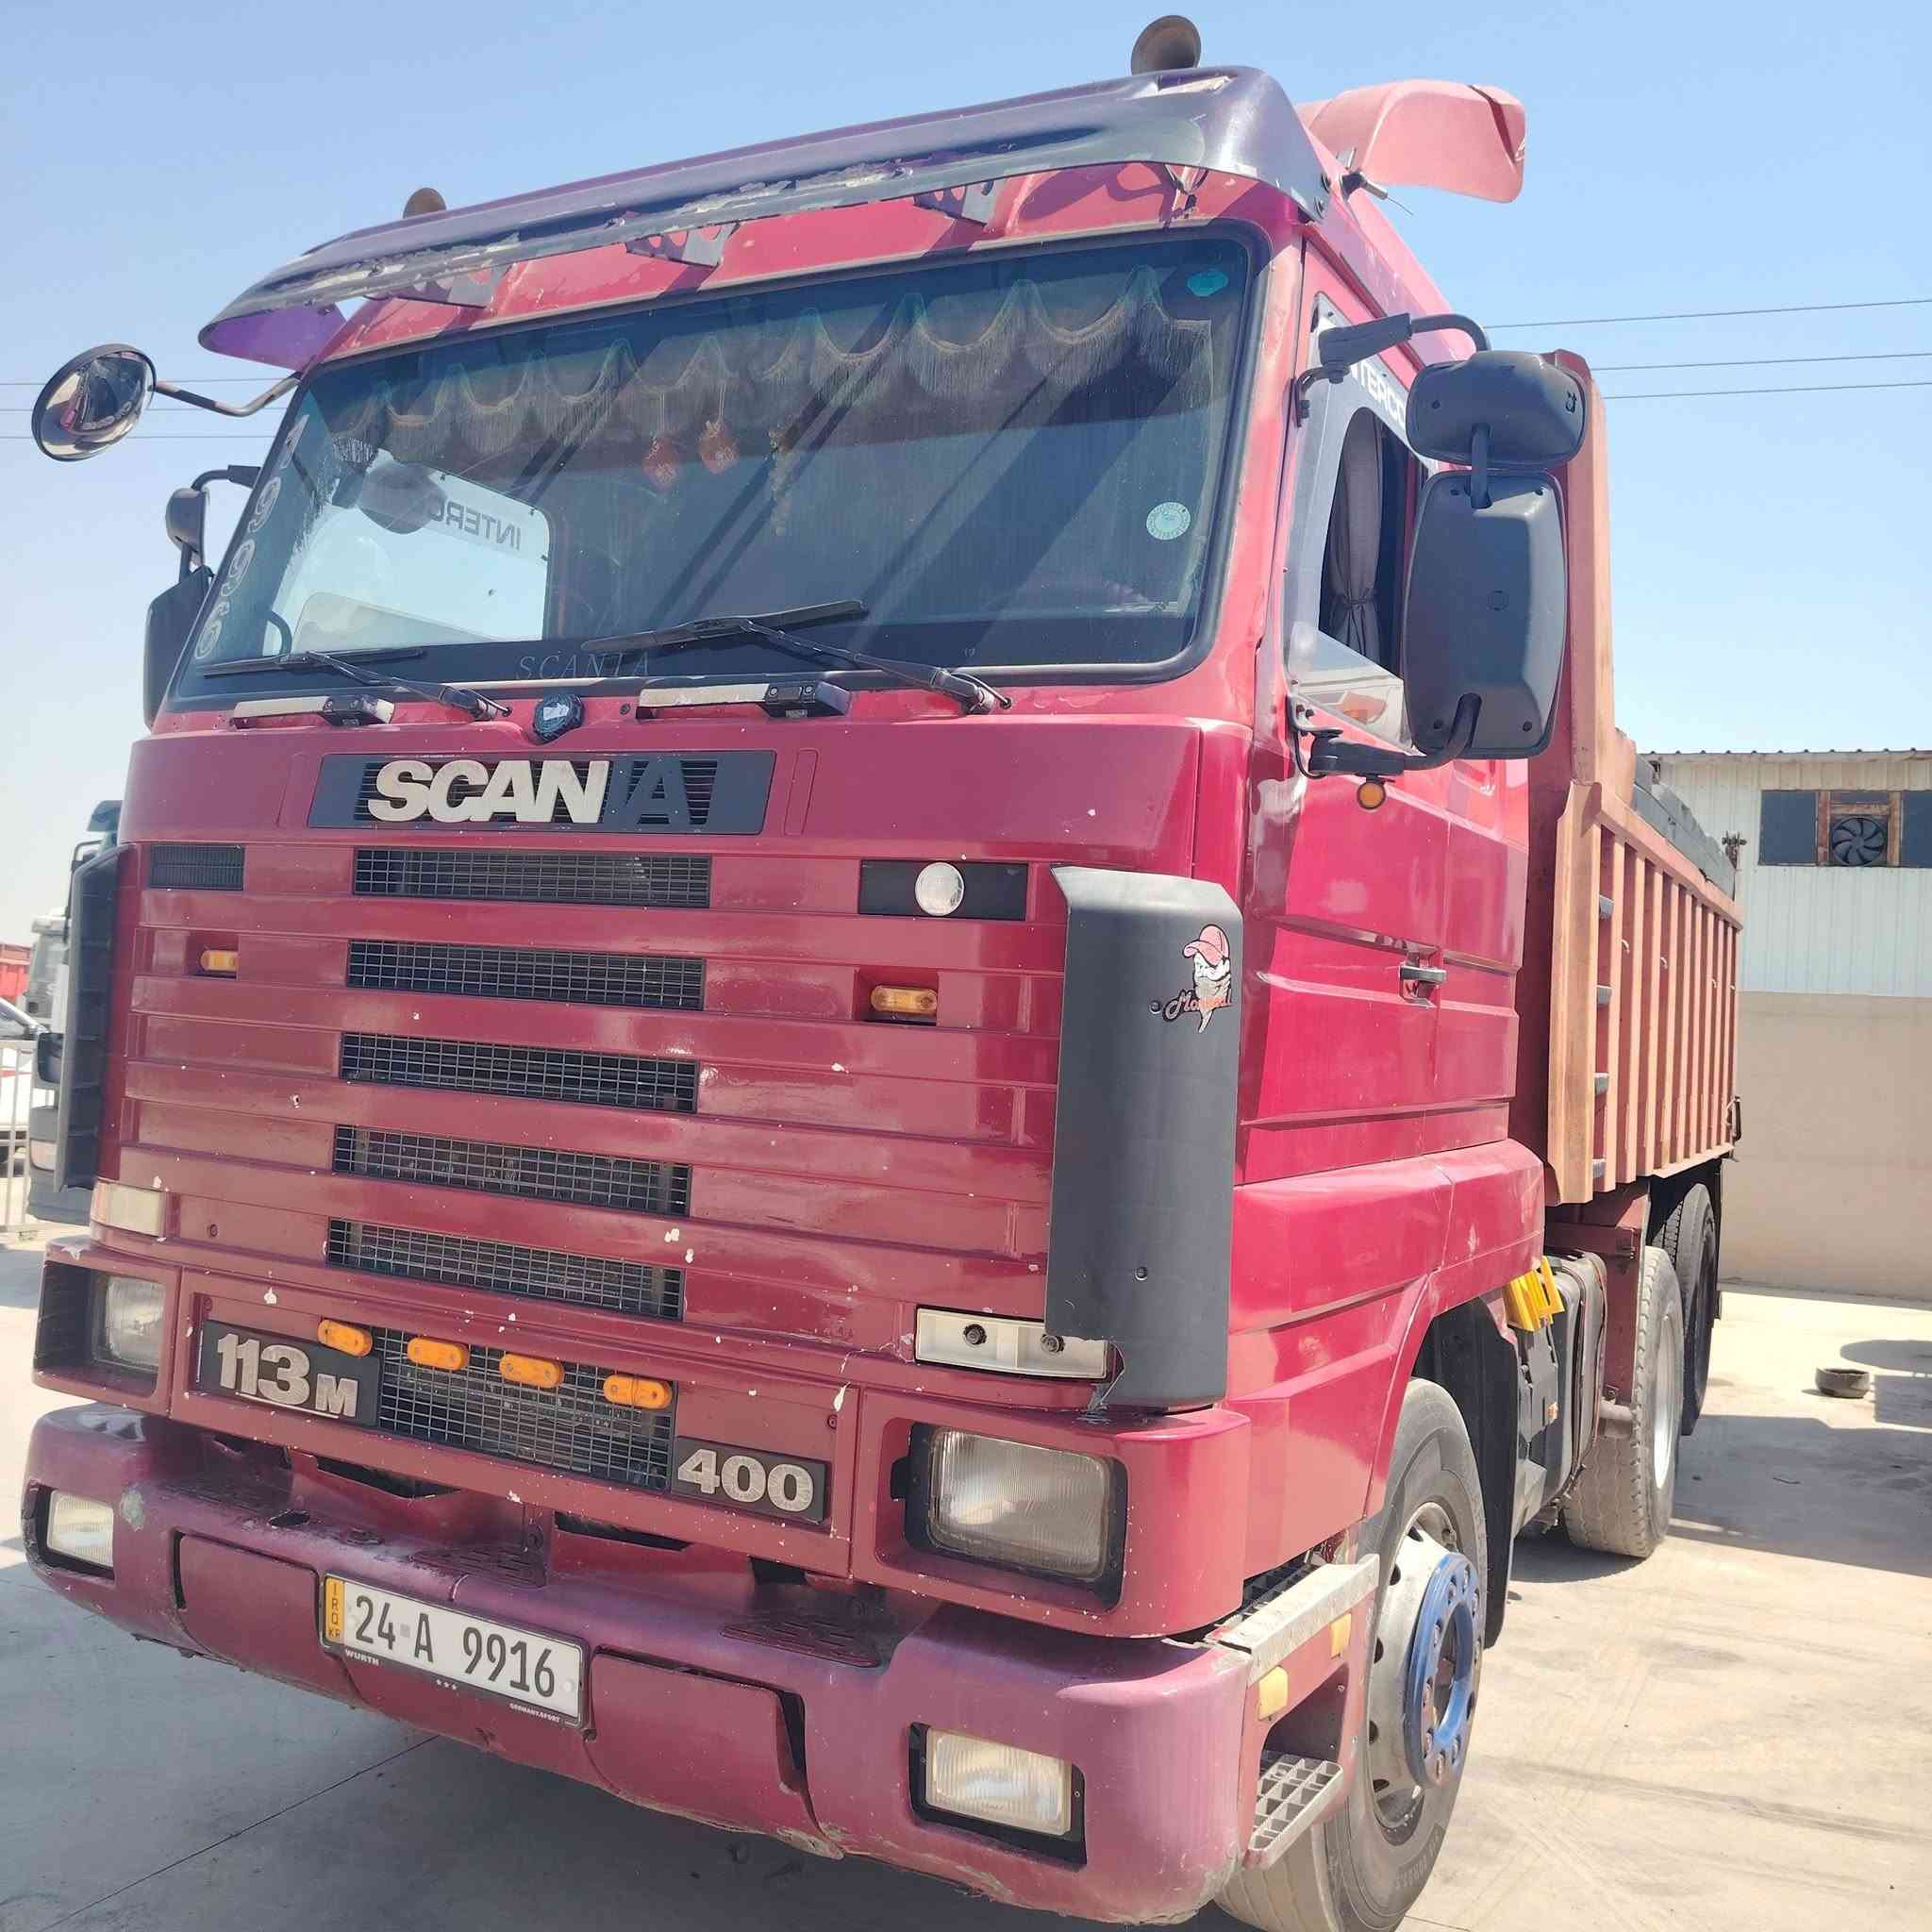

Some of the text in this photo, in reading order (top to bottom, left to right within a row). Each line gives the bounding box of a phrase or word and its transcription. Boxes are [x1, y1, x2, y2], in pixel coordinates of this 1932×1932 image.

[516, 650, 650, 680] SCANIA
[367, 759, 691, 825] SCANIA
[217, 1333, 358, 1418] 113 M
[677, 1448, 814, 1512] 400
[355, 1595, 556, 1698] 24 A 9916
